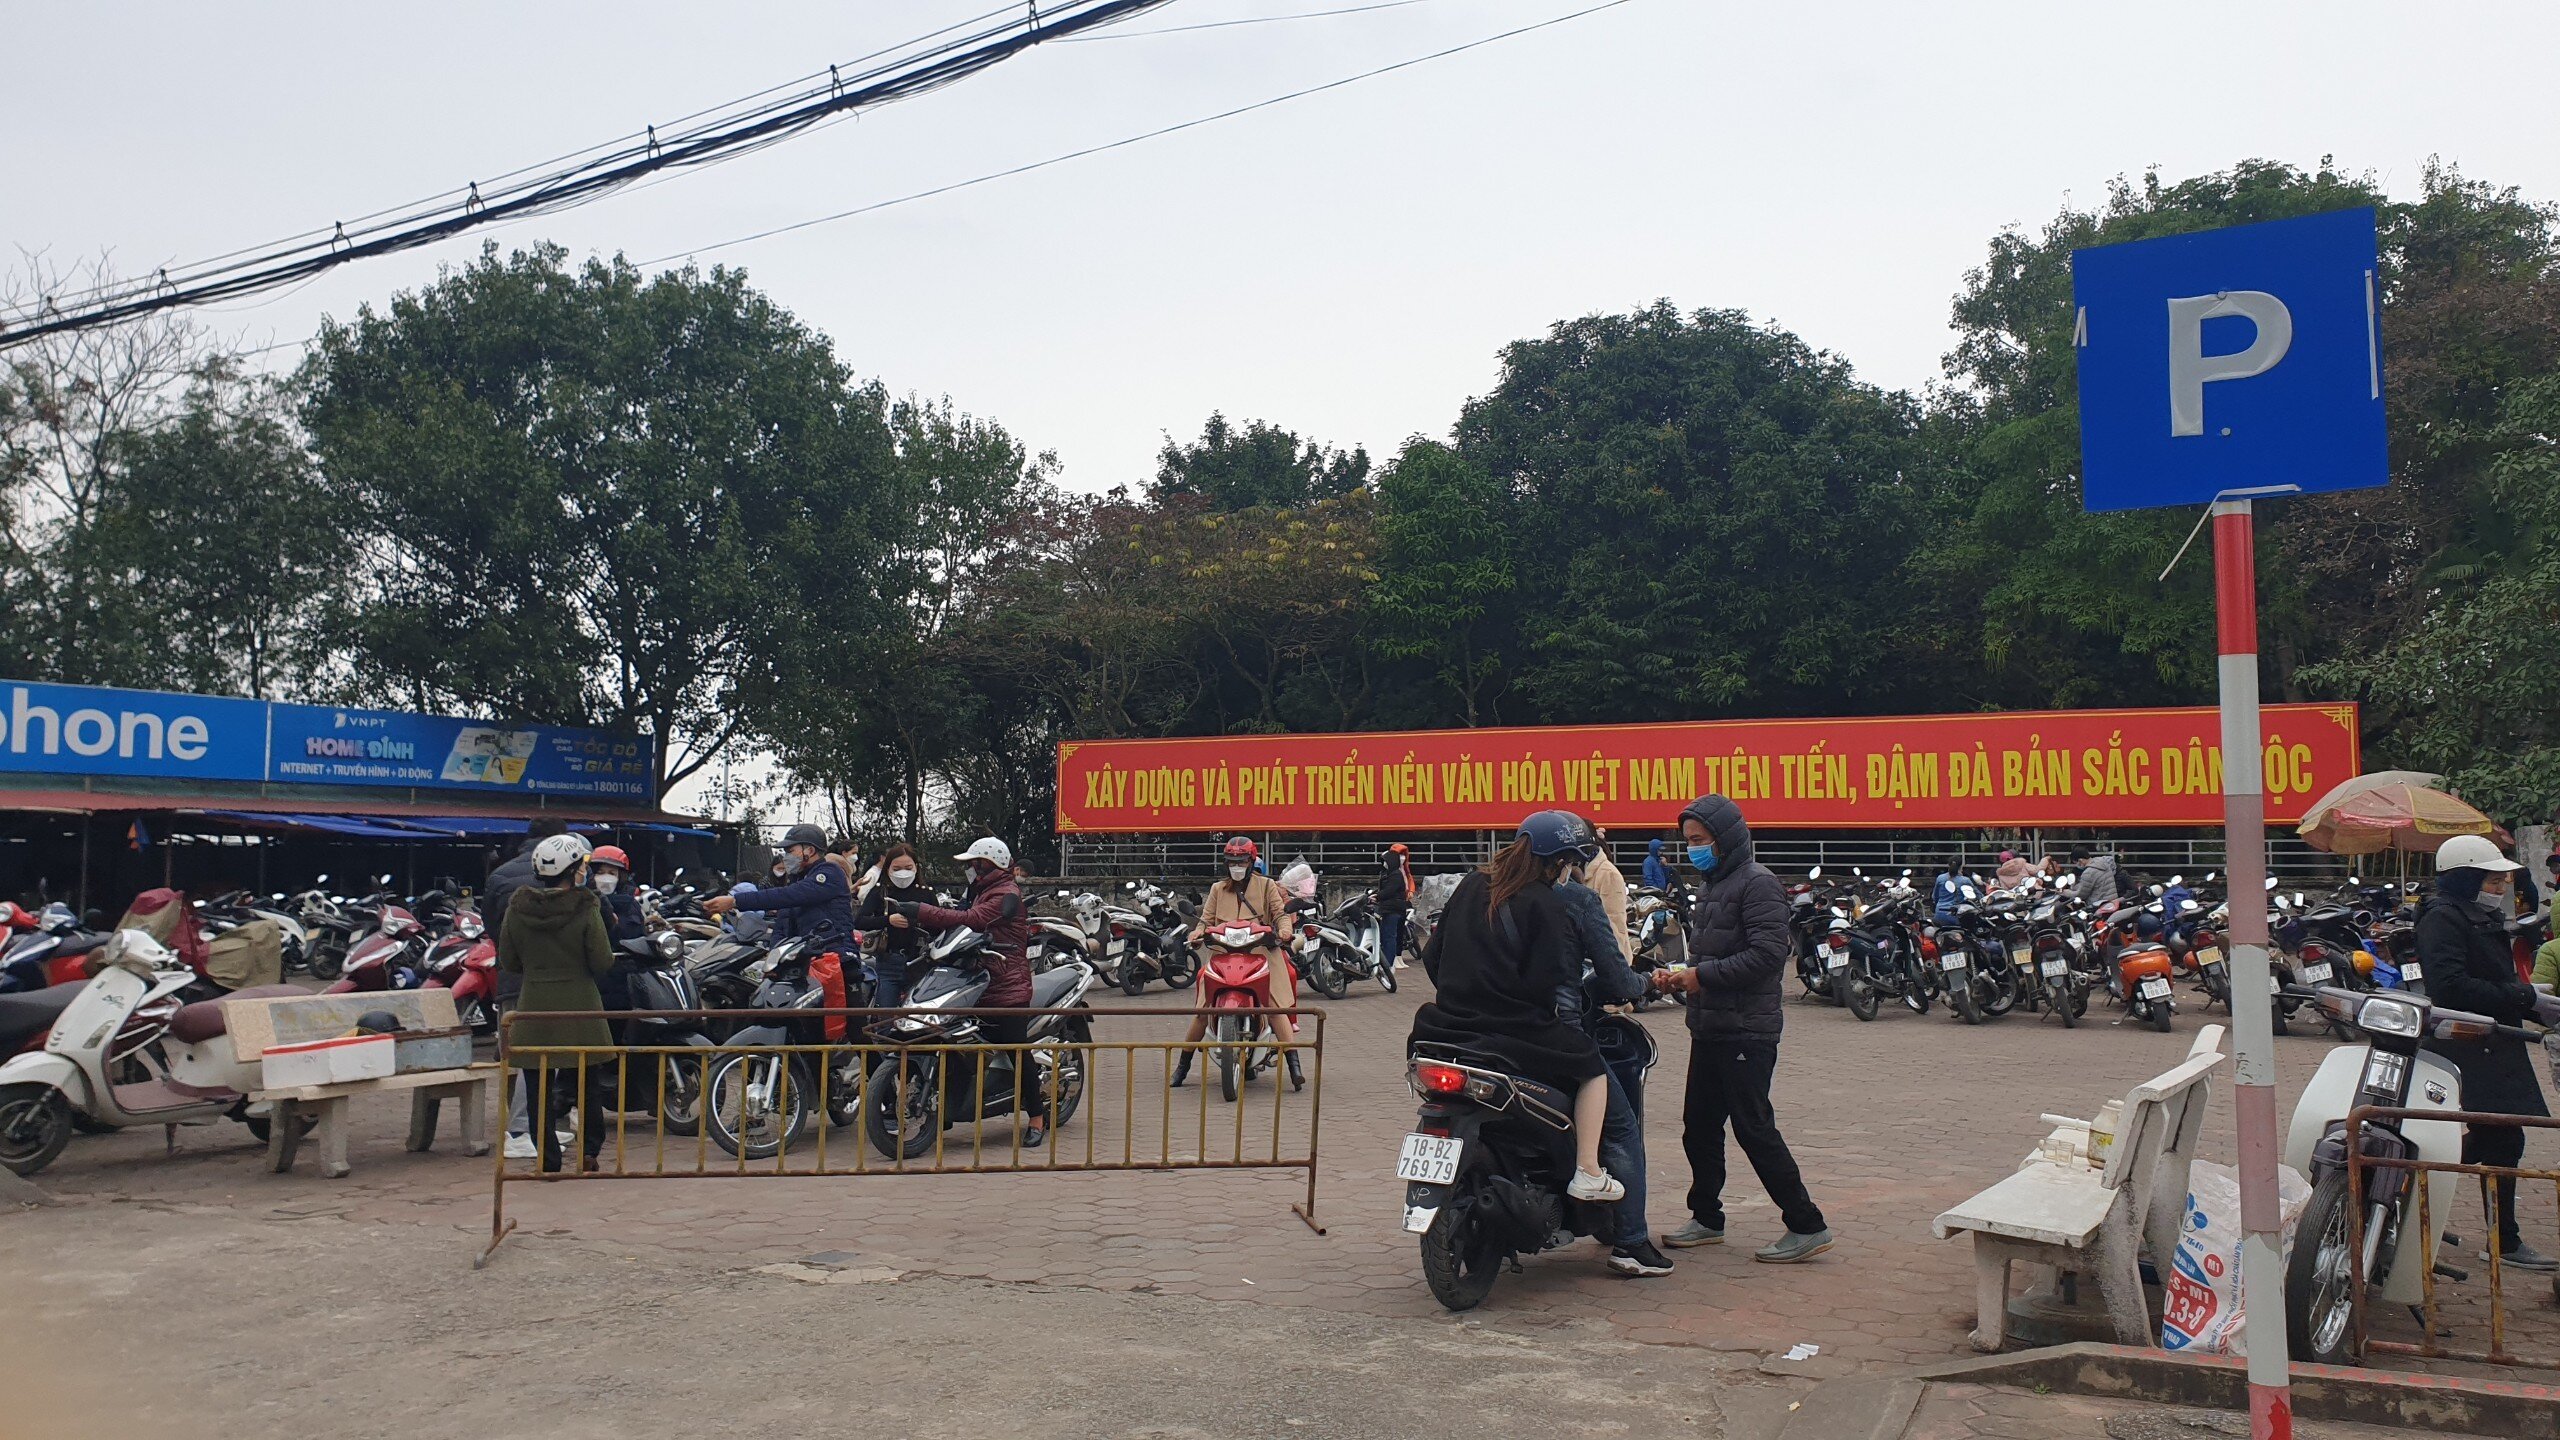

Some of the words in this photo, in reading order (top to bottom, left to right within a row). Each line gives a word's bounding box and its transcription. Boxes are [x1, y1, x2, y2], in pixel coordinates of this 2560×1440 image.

[2167, 290, 2292, 437] P
[0, 687, 209, 761] hone
[350, 717, 387, 728] VNPT
[306, 736, 364, 757] HOME
[280, 762, 325, 775] INTERNET
[398, 767, 407, 778] DI
[585, 757, 614, 774] GIÁ
[1085, 762, 1128, 808] XÂY
[1134, 765, 1195, 816] DỰNG
[1202, 759, 1232, 806] VÀ
[1238, 757, 1298, 806] PHÁT
[1304, 748, 1374, 805] TRIỂN
[1382, 750, 1434, 804] NỀN
[1441, 753, 1493, 803] VĂN
[1501, 751, 1556, 802] HÓA
[1562, 750, 1621, 811] VIỆT
[1629, 757, 1696, 801] NAM
[1704, 746, 1771, 799] TIÊN
[1779, 739, 1857, 805] TIẾN,
[1866, 743, 1939, 809] ĐẬM
[1948, 741, 1994, 798] ĐÀ
[2002, 733, 2072, 797] BẢN
[2082, 729, 2150, 796] SẮC
[2261, 734, 2313, 805] ỘC
[594, 781, 643, 793] 18001166
[1413, 1138, 1453, 1160] 18-B2
[1400, 1157, 1454, 1180] 769.79
[2207, 1258, 2220, 1273] M1
